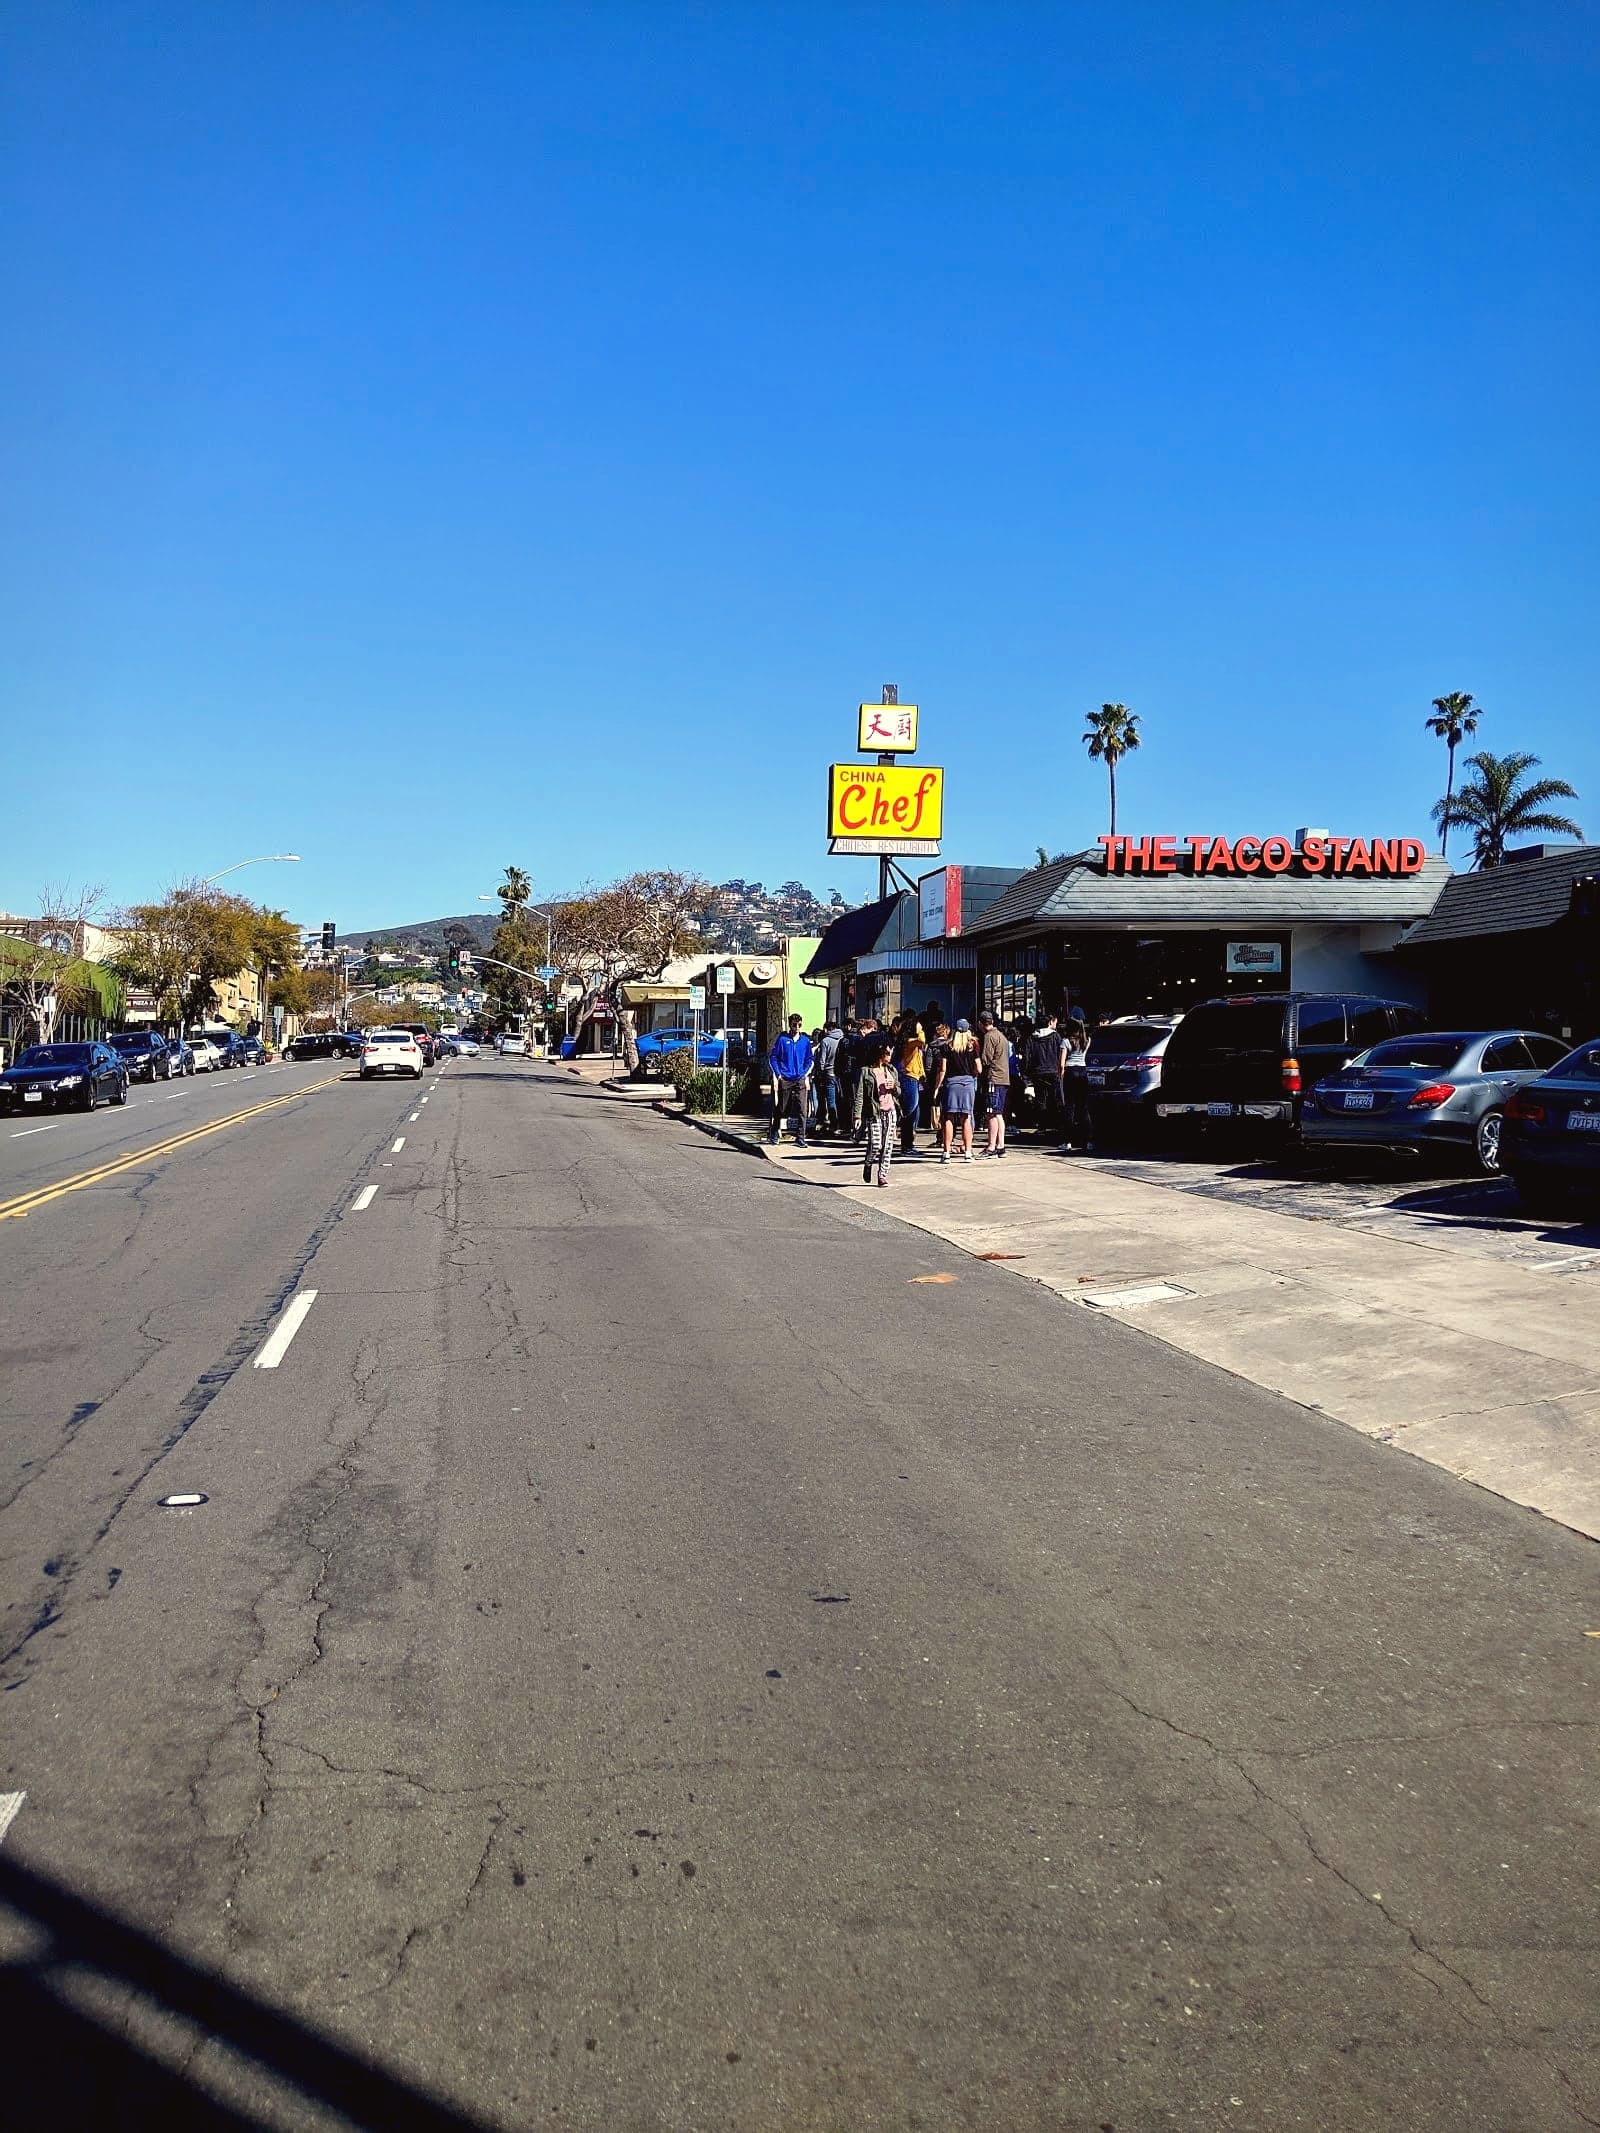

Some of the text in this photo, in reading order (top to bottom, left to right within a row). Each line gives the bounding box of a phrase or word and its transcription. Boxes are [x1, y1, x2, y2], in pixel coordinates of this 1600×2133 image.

[840, 770, 886, 783] CHINA
[839, 773, 937, 833] Chef
[1098, 836, 1425, 873] THE TACO STAND
